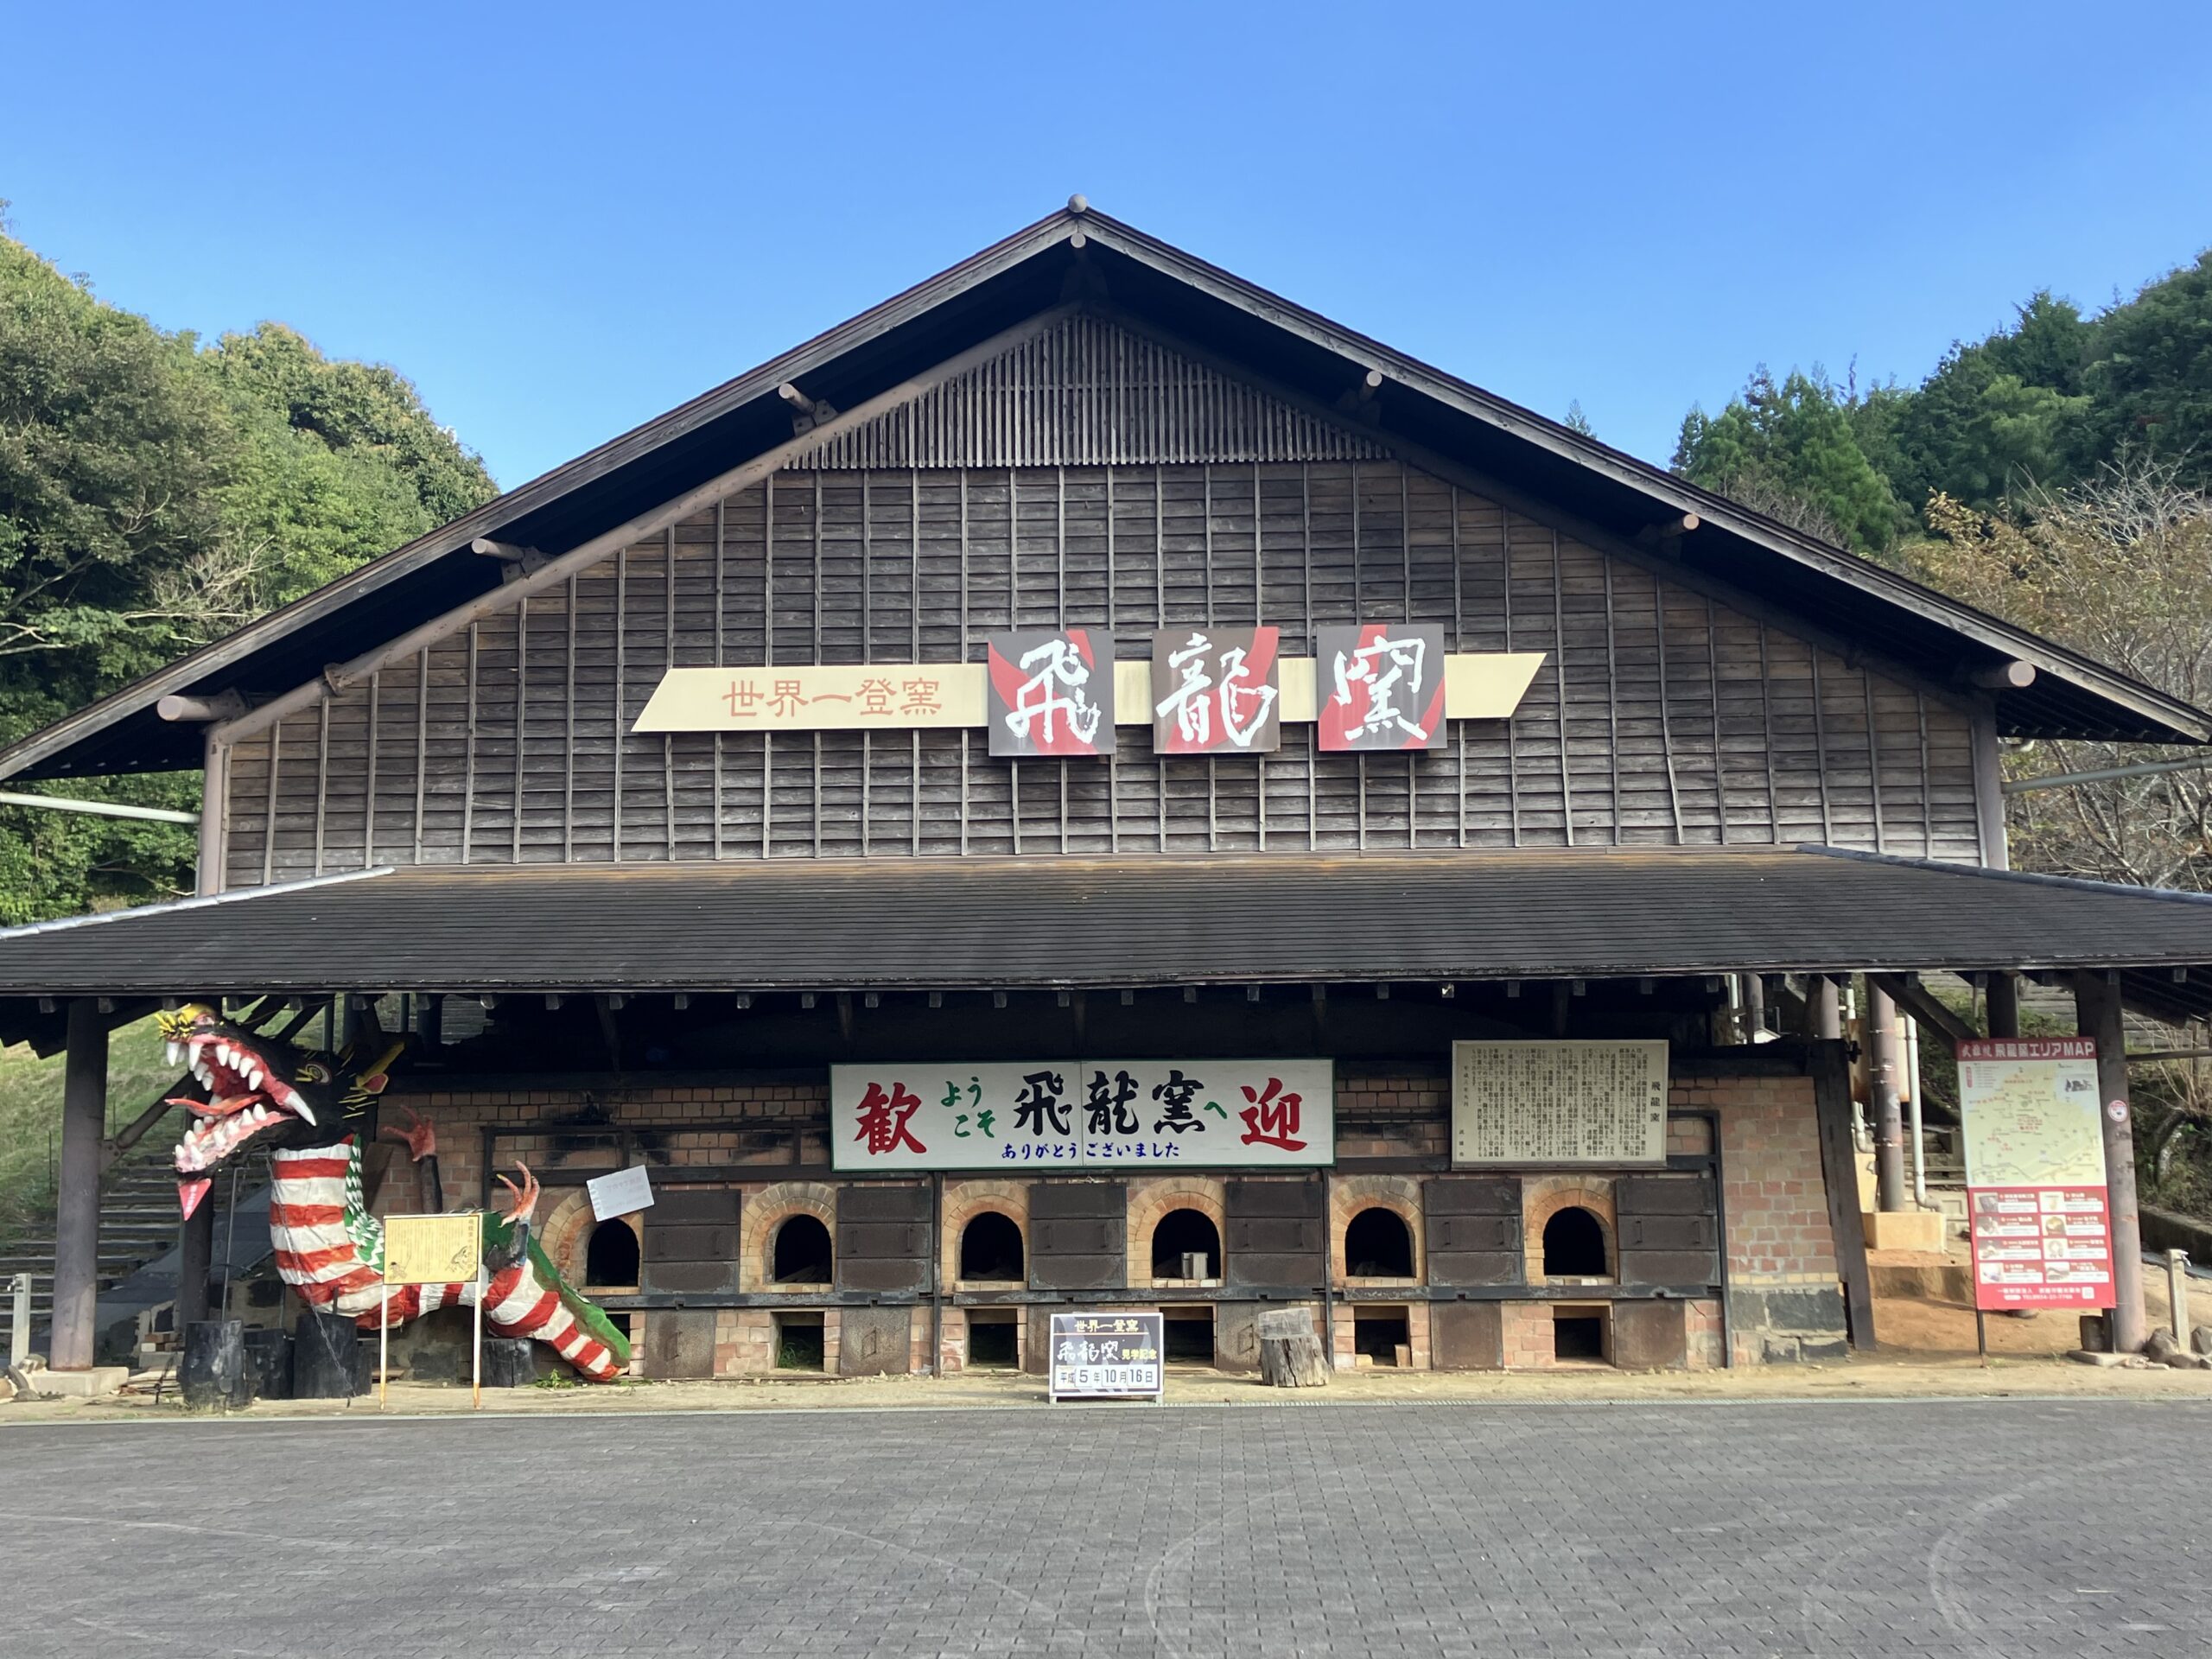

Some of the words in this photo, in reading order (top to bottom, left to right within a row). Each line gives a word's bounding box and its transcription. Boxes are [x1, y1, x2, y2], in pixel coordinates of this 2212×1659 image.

[721, 677, 943, 718] 世界一登窯
[1003, 632, 1427, 747] 飛龍窯
[940, 1077, 982, 1109] よう
[854, 1082, 927, 1155] 歓
[955, 1109, 995, 1138] こそ
[1238, 1077, 1307, 1153] 迎
[1001, 1141, 1180, 1160] ありがとうございました
[1075, 1319, 1139, 1332] 世界一登窯
[1057, 1340, 1119, 1362] 飛龍窯
[1122, 1349, 1157, 1360] 見学記念
